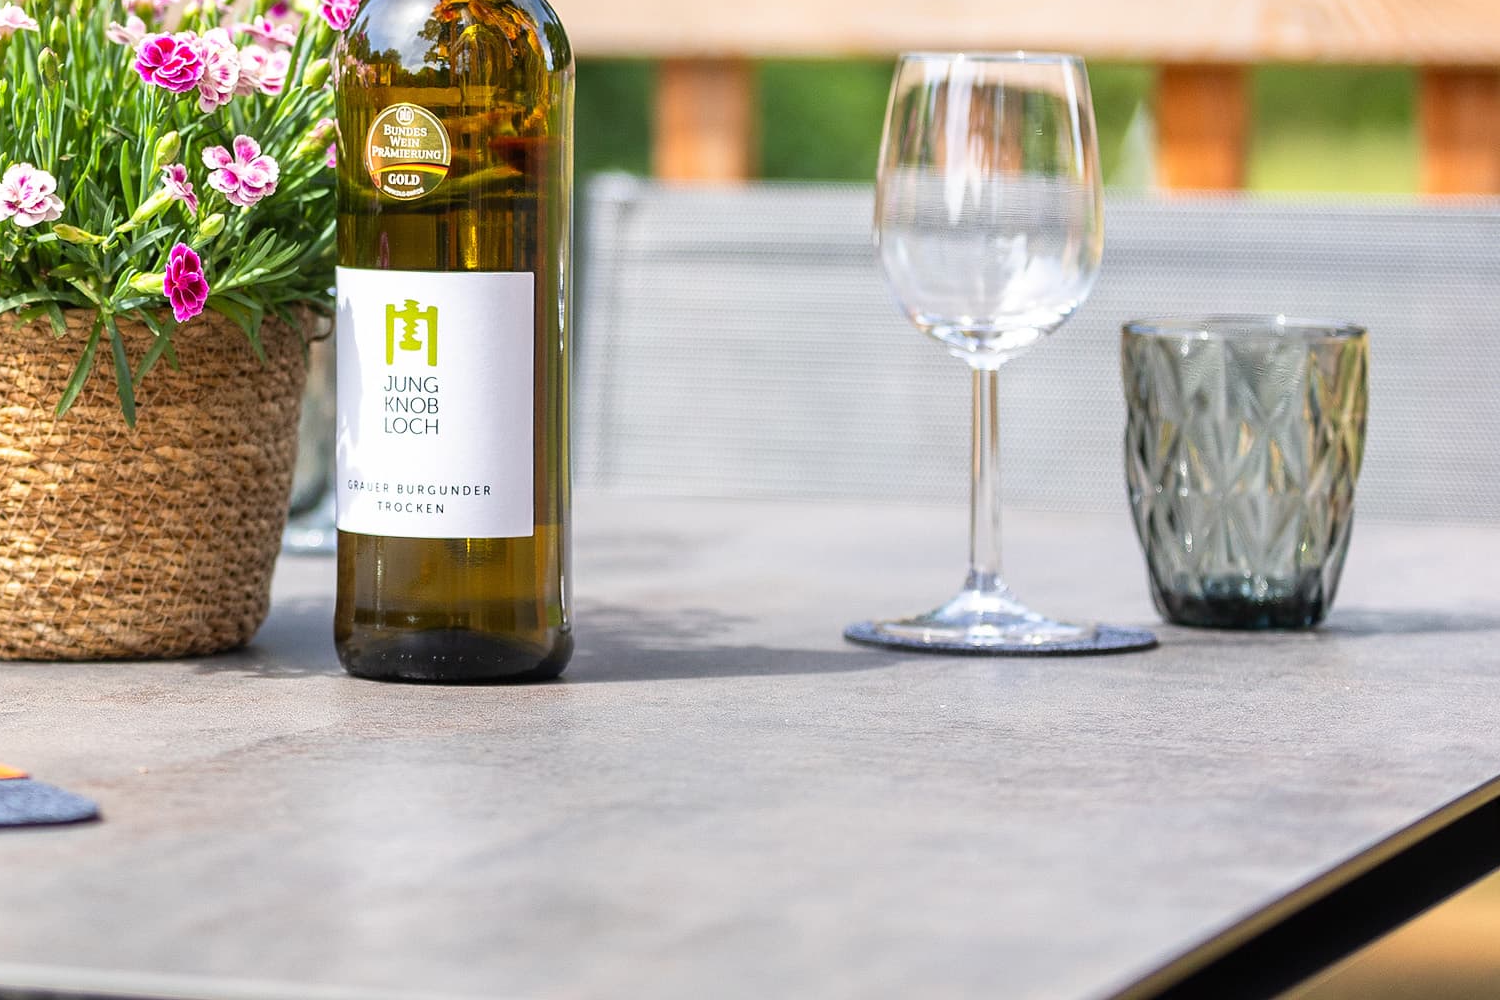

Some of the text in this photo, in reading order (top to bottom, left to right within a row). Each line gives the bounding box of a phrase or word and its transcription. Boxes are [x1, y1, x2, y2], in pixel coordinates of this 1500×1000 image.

[383, 124, 428, 137] BUNDES
[389, 136, 420, 148] WEIN
[372, 145, 441, 160] PRÄMIERUNG
[388, 173, 421, 186] GOLD
[384, 375, 439, 393] JUNG
[384, 396, 439, 414] KNOB
[384, 417, 439, 435] LOCH
[347, 479, 492, 496] GRAUER BURGUNDER
[377, 501, 445, 514] TROCKEN
